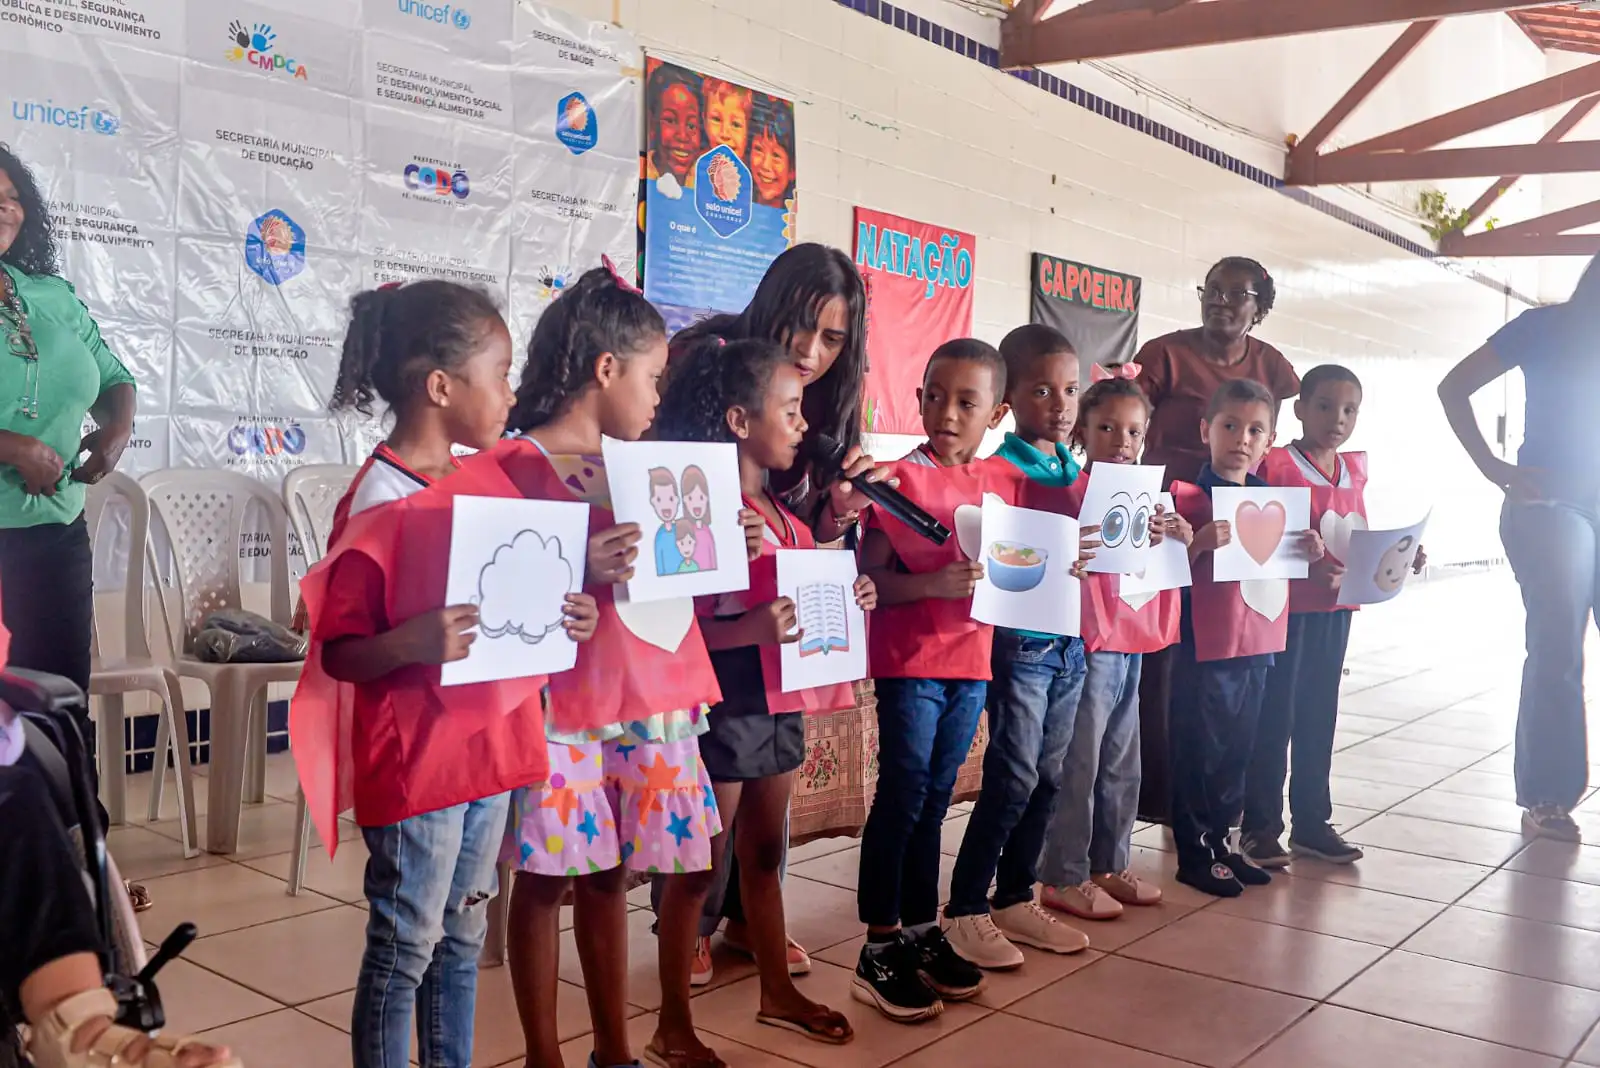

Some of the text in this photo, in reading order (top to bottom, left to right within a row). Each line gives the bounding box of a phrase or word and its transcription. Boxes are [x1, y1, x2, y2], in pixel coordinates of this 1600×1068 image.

[80, 1, 146, 23] SEGURANÇA
[44, 7, 52, 17] E
[53, 9, 162, 40] DESENVOLVIMENTO
[247, 50, 308, 81] CMDCA
[376, 61, 428, 82] SECRETARIA
[376, 73, 503, 111] DE DESENVOLVIMENTO SOCIAL
[376, 87, 485, 119] E SEGURANÇA ALIMENTAR
[12, 99, 89, 130] unicef
[215, 129, 336, 161] SECRETARIA MUNICIPAL
[240, 149, 314, 171] DE EDUCAÇÃO
[532, 189, 579, 206] SECRETARIA
[60, 201, 120, 219] MUNICIPAL
[74, 217, 139, 236] SEGURANÇA
[676, 224, 691, 234] que
[856, 220, 973, 300] NATAÇÃO
[469, 271, 498, 284] SOCIAL
[1040, 256, 1136, 313] CAPOEIRA
[208, 328, 334, 347] SECRETARIA MUNICIPAL
[234, 345, 249, 356] DE
